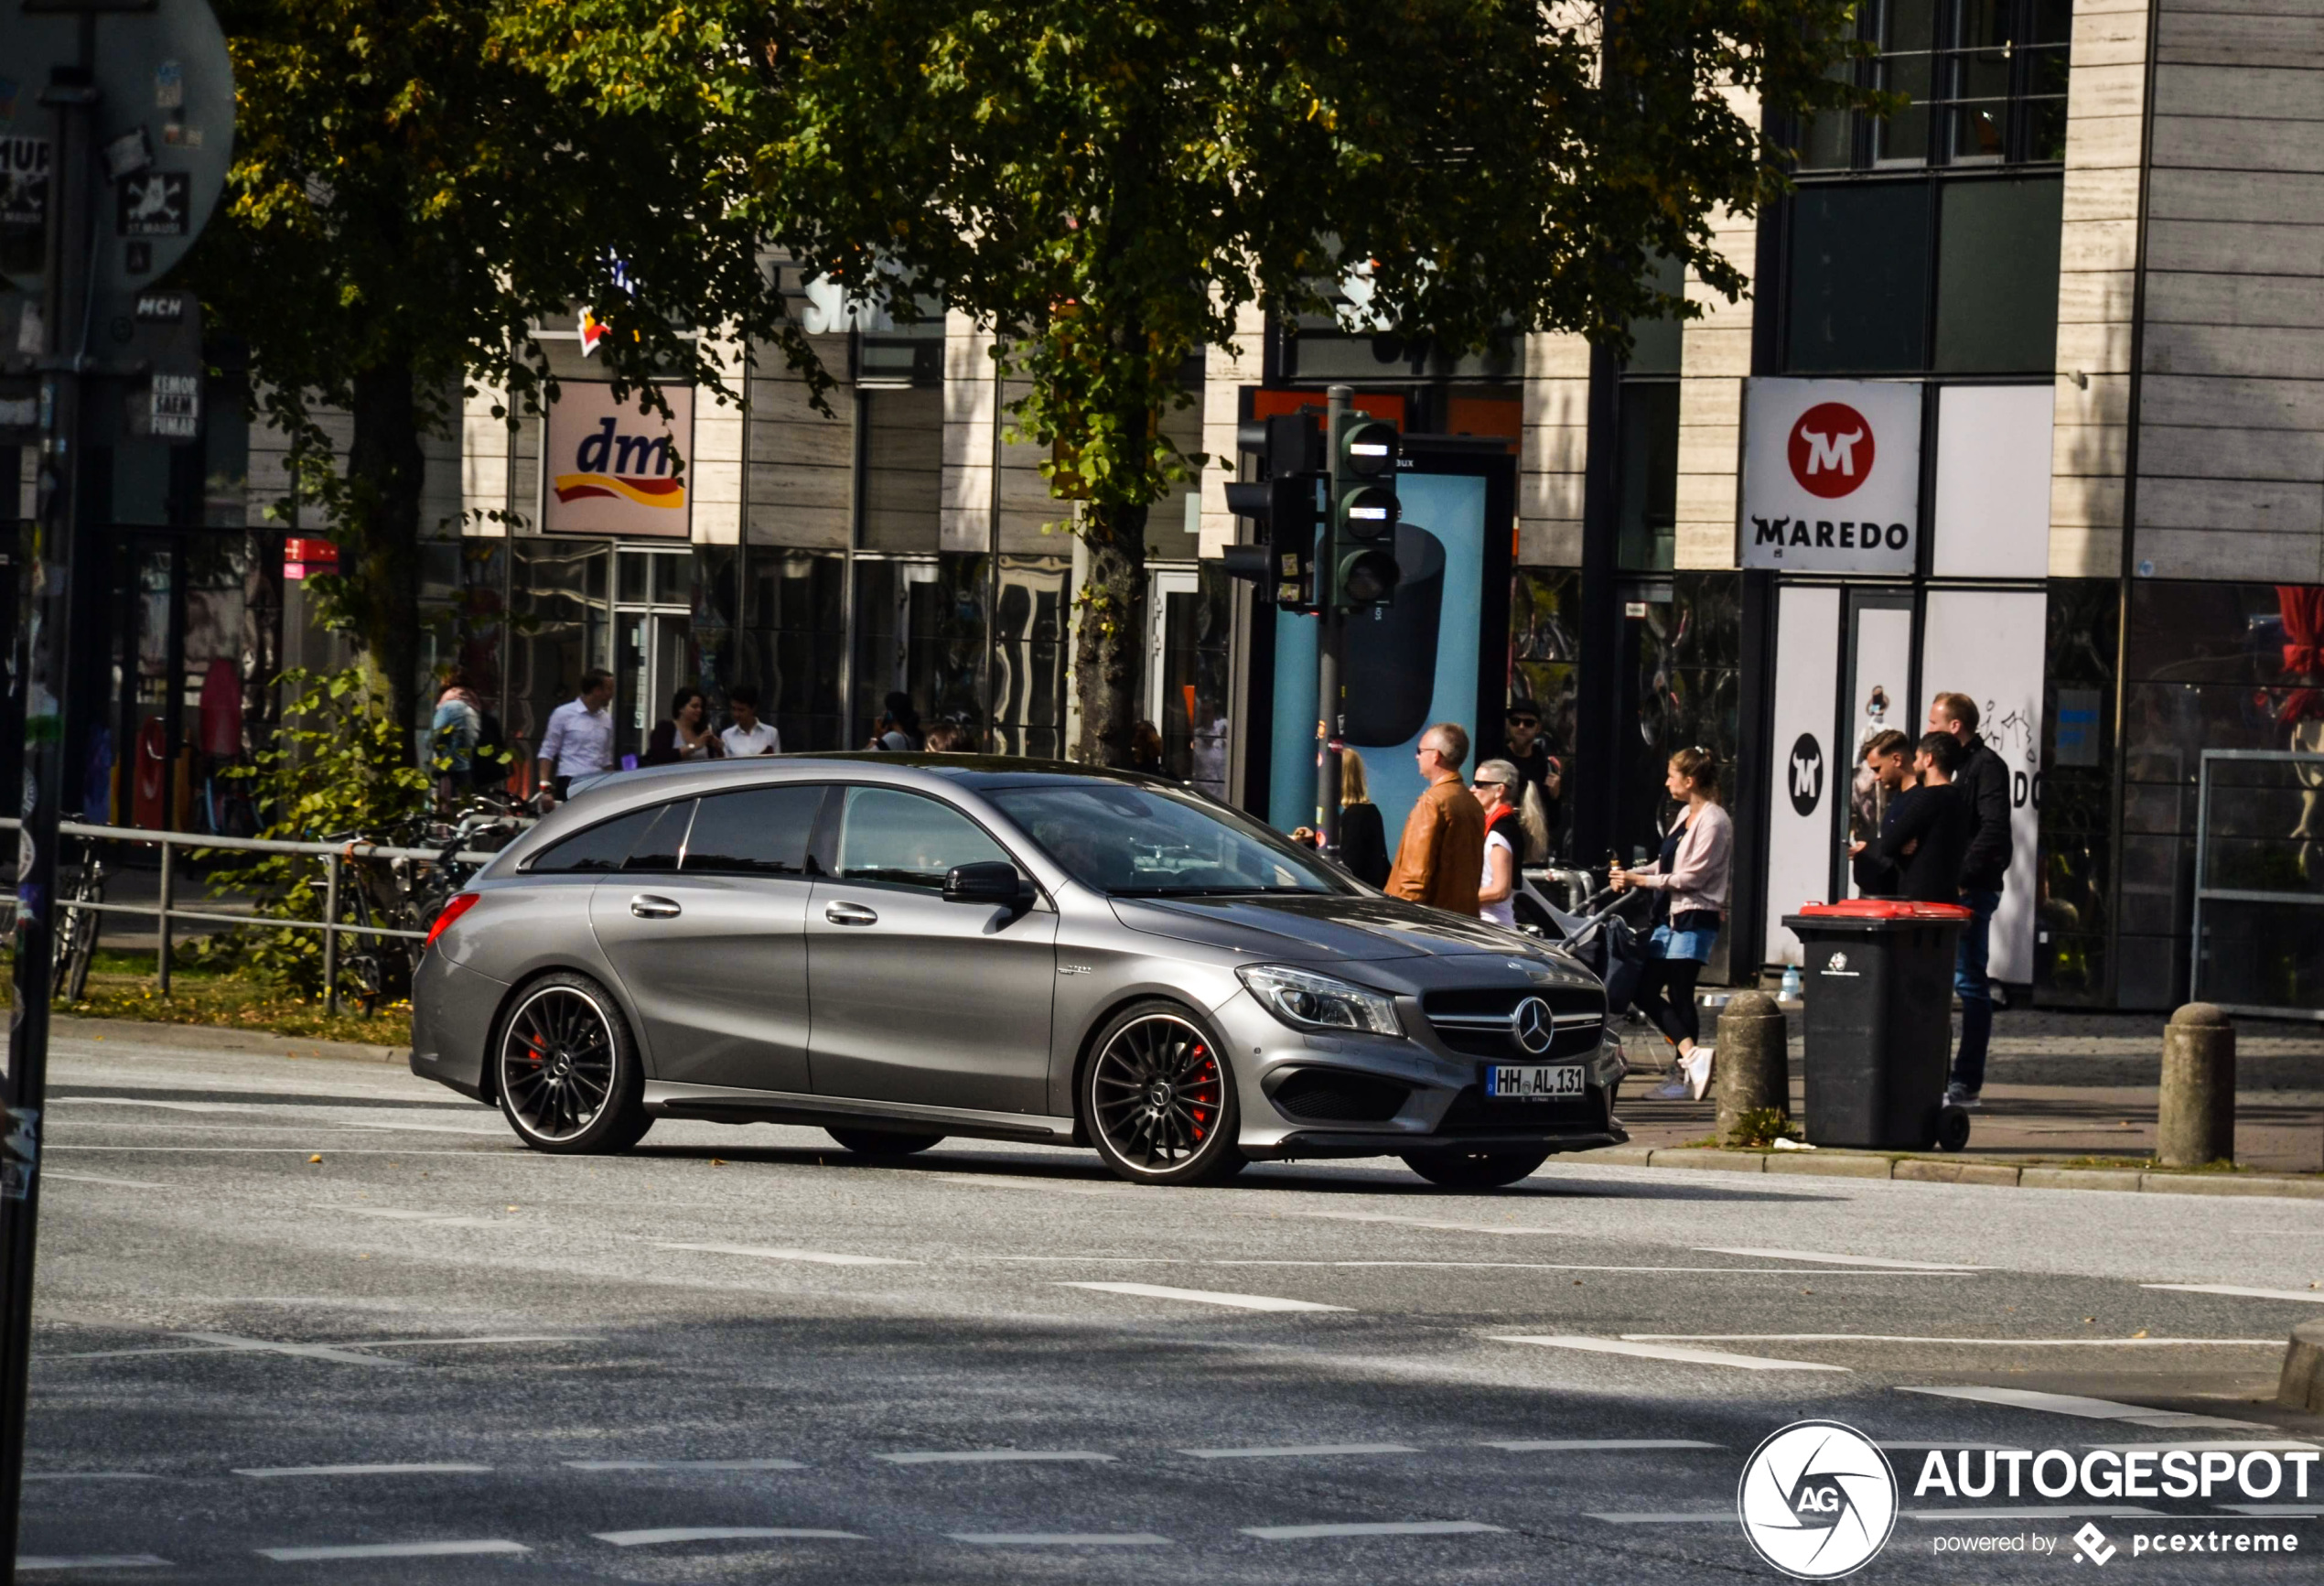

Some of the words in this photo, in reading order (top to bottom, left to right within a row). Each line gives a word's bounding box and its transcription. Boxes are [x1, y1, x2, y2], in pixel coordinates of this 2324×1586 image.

[136, 298, 181, 316] MCH
[576, 417, 668, 475] dm
[1751, 513, 1910, 551] MAREDO
[1497, 1069, 1522, 1094] HH
[1533, 1069, 1554, 1094] AL
[1556, 1068, 1583, 1093] 131
